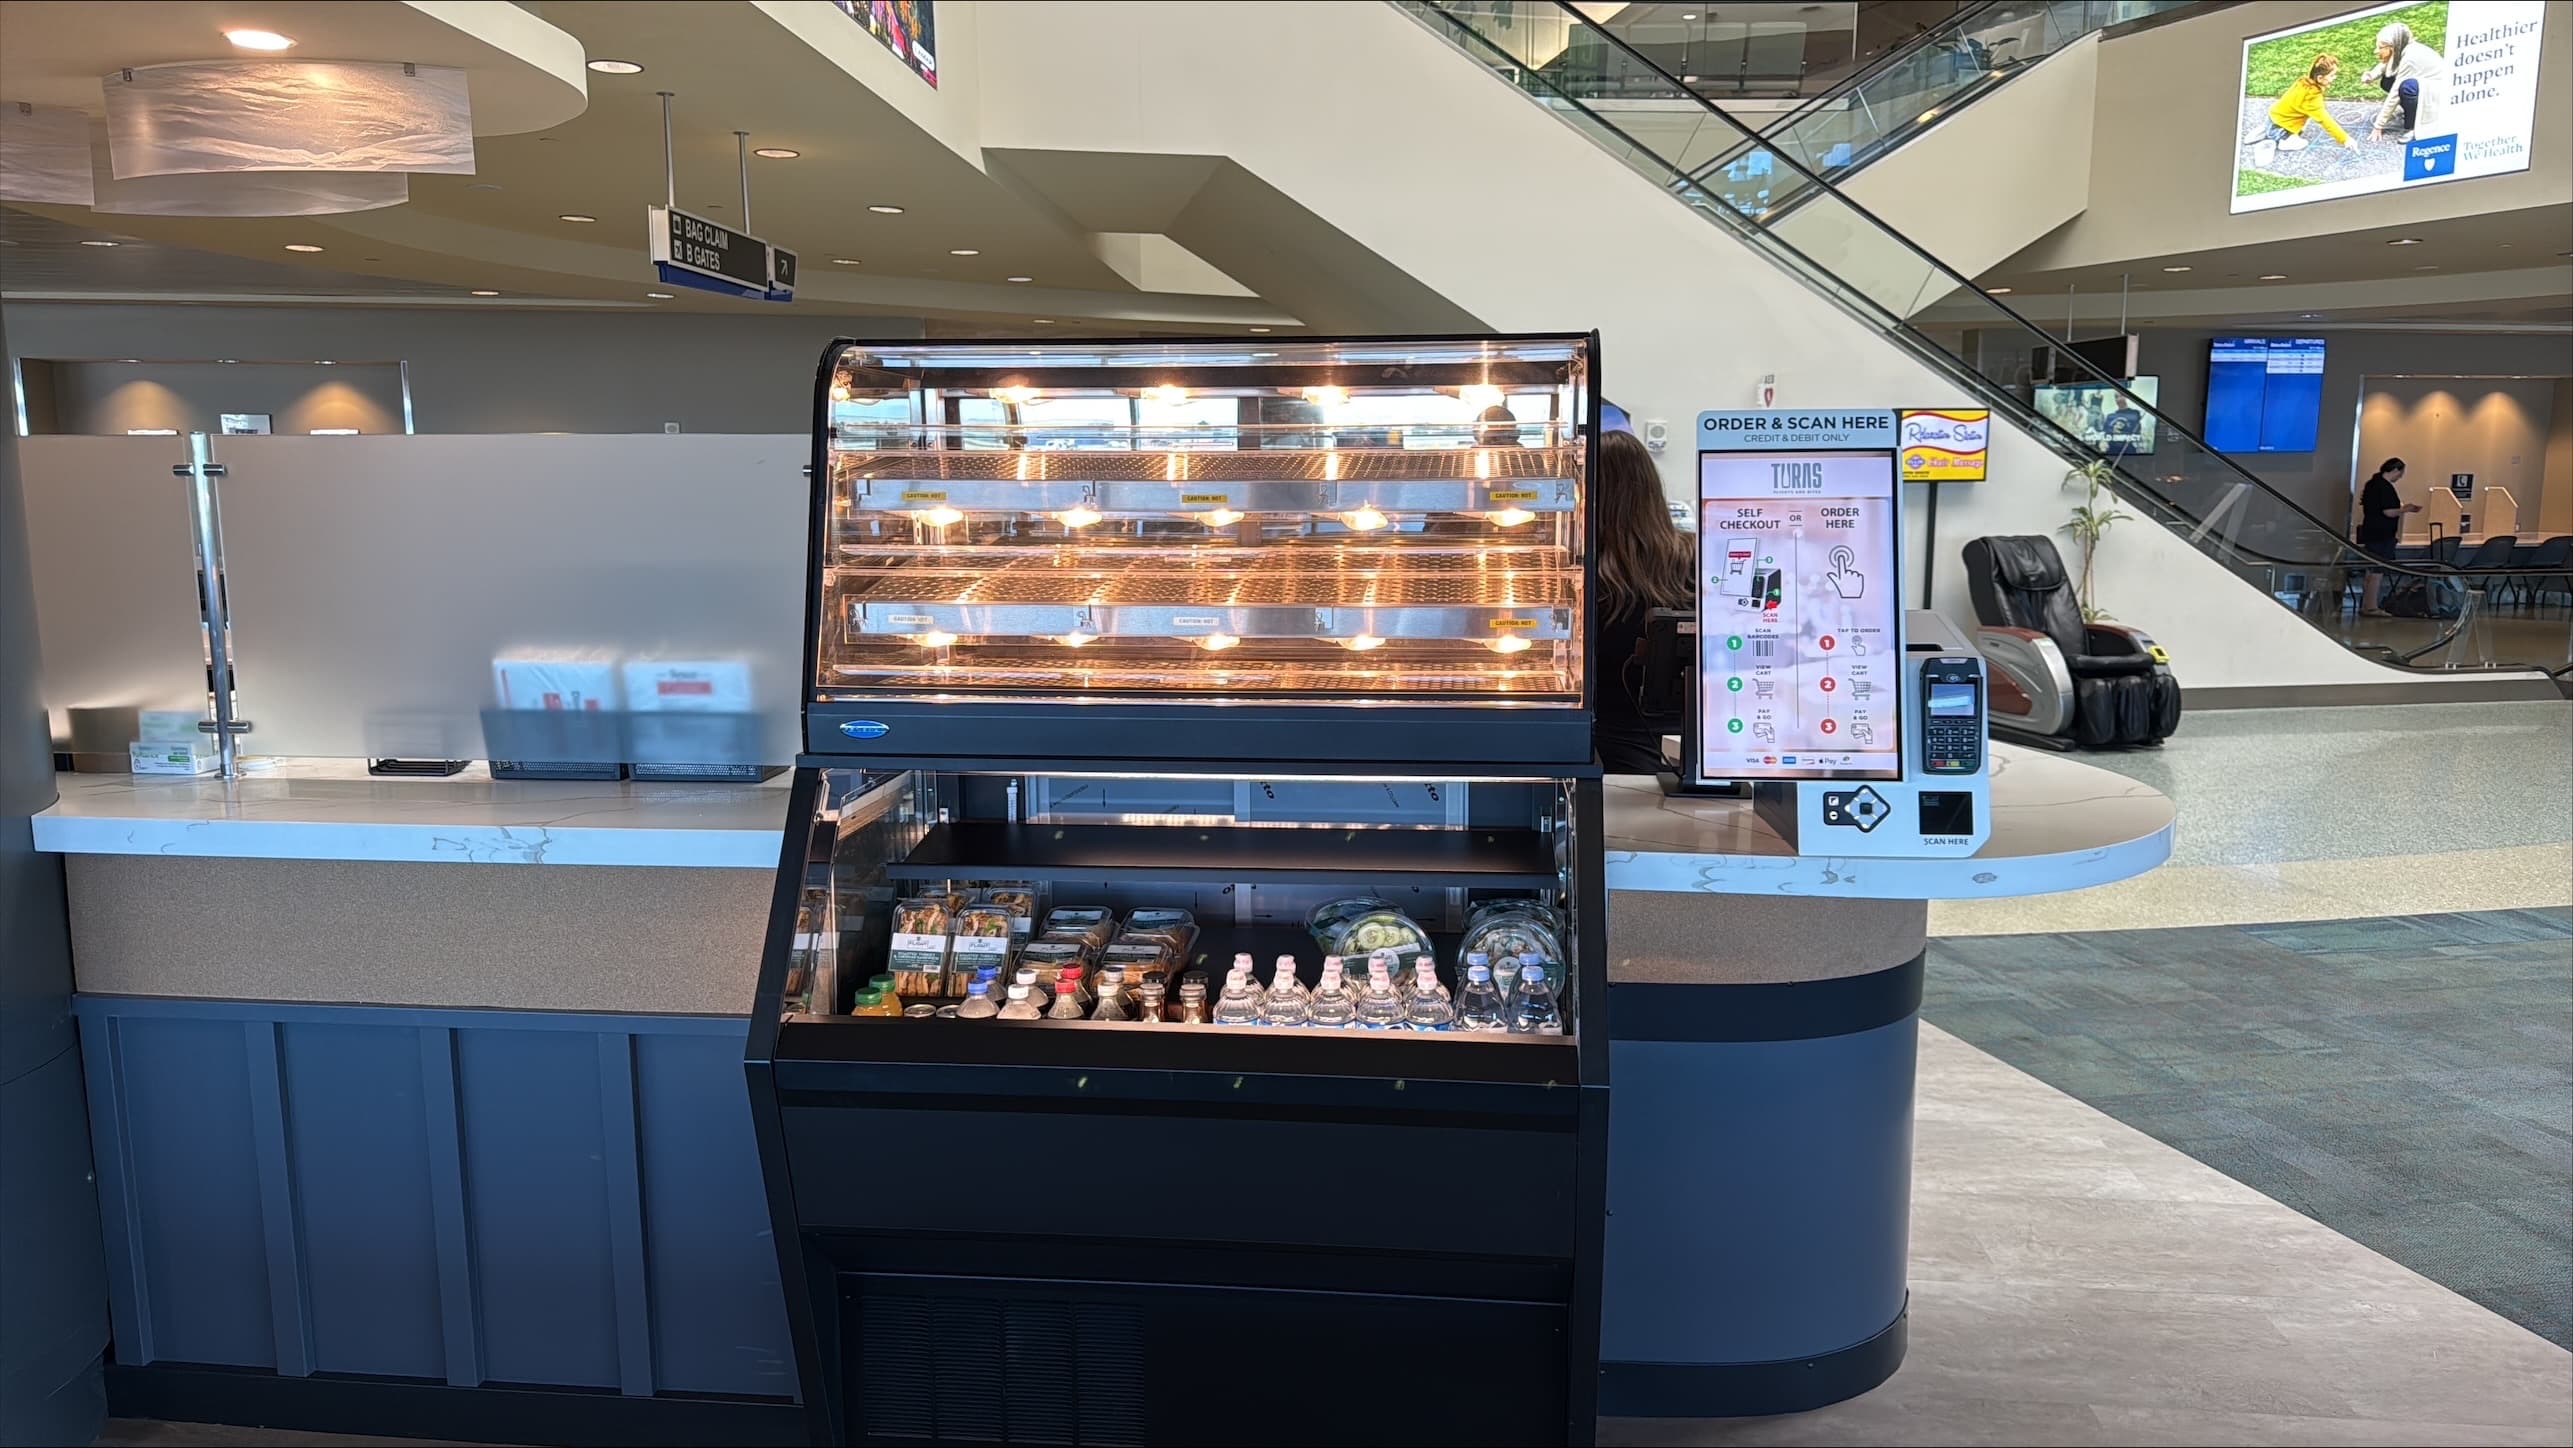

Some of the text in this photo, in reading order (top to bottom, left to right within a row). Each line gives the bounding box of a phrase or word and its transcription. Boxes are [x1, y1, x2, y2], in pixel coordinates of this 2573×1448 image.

[2457, 21, 2538, 48] Healthier
[2454, 42, 2516, 67] doesn't
[2452, 65, 2514, 86] happen
[2450, 88, 2500, 105] alone.
[2464, 136, 2516, 151] Together
[2412, 143, 2451, 157] Regence
[2463, 143, 2523, 161] We Health
[686, 219, 729, 250] BAG CLAIM
[687, 244, 721, 271] B GATES
[1703, 416, 1889, 431] ORDER & SCAN HERE
[1744, 433, 1850, 443] CREDIT & DEBIT ONLY
[1737, 508, 1763, 518] SELF
[1821, 507, 1860, 517] ORDER
[1789, 514, 1802, 522] OR
[1720, 520, 1781, 530] CHECKOUT
[1826, 519, 1855, 529] HERE
[1731, 640, 1737, 648] 1
[1731, 680, 1739, 689] 2
[1824, 680, 1832, 689] 2
[1732, 721, 1739, 731] 3
[1825, 722, 1833, 731] 3
[1923, 838, 1946, 846] SCAN
